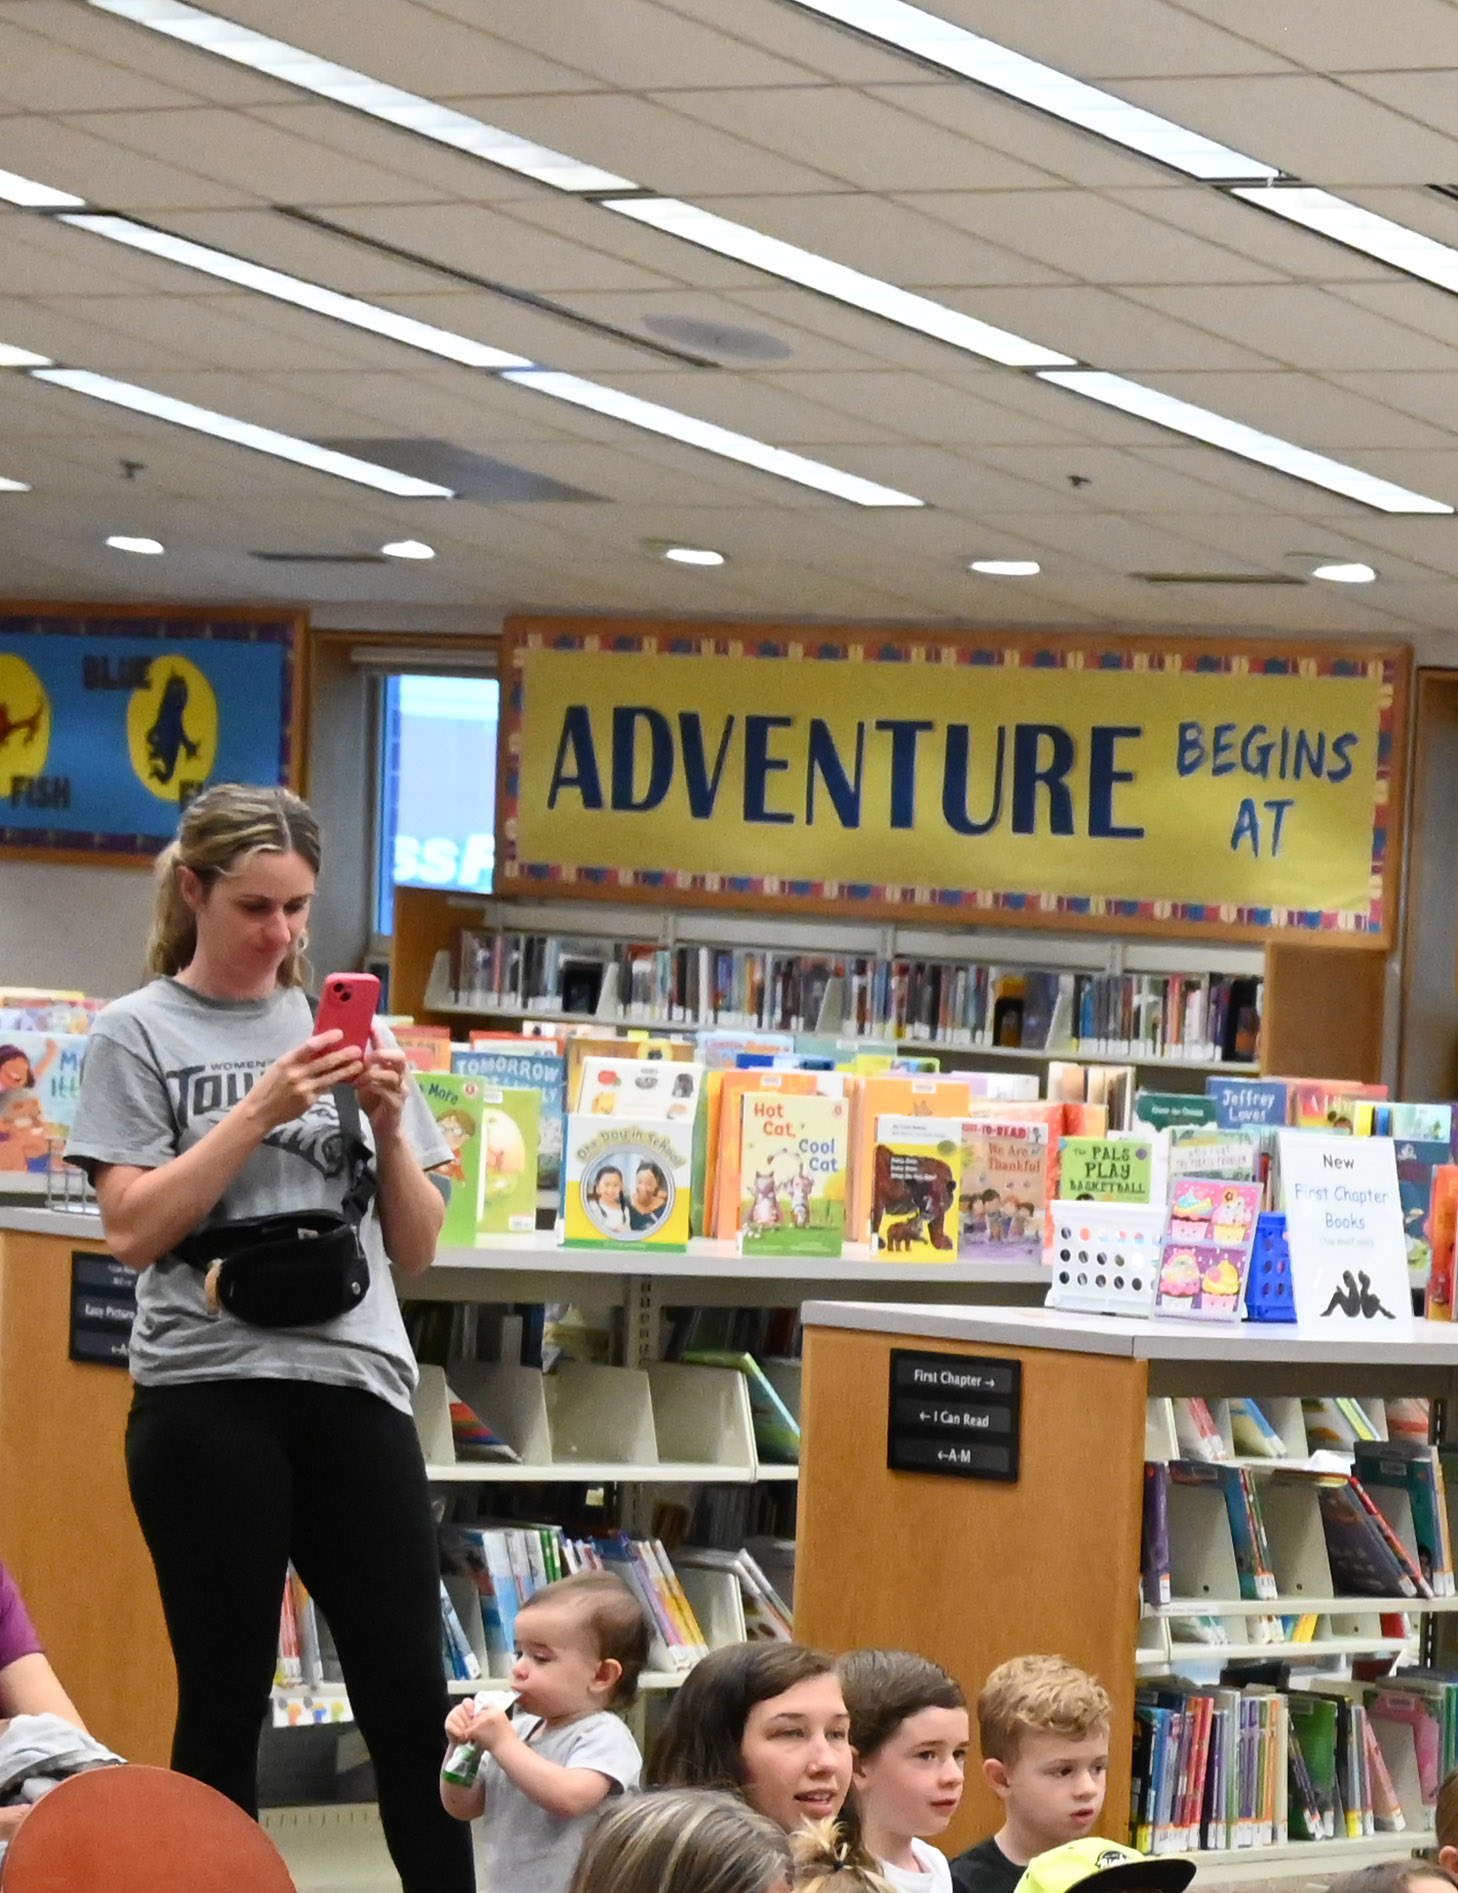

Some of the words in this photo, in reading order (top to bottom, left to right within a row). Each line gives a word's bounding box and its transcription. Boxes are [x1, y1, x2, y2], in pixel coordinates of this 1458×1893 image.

[1176, 721, 1360, 784] BEGINS
[547, 704, 1145, 840] ADVENTURE
[1230, 797, 1295, 858] AT
[210, 1059, 278, 1072] WOMEN
[456, 1058, 561, 1083] TOMORROW
[166, 1064, 266, 1132] TOU
[428, 1082, 459, 1106] More
[1222, 1088, 1276, 1110] Jeffrey
[753, 1102, 784, 1119] Hot
[1228, 1106, 1267, 1122] Loves
[762, 1121, 796, 1138] Cat,
[601, 1128, 629, 1142] Day
[648, 1133, 687, 1167] School
[799, 1138, 836, 1155] Cool
[1092, 1145, 1130, 1162] PALS
[808, 1157, 838, 1173] Cat
[988, 1157, 1041, 1173] Thankful
[1323, 1153, 1355, 1169] New
[1085, 1161, 1131, 1180] PLAY
[1069, 1178, 1146, 1194] BASKETBALL
[1294, 1183, 1328, 1200] First
[1334, 1185, 1390, 1206] Chapter
[1325, 1212, 1366, 1230] Books
[914, 1368, 938, 1384] First
[940, 1371, 982, 1388] Chapter
[940, 1410, 960, 1425] Can
[964, 1412, 989, 1428] Read
[948, 1448, 972, 1464] A-M
